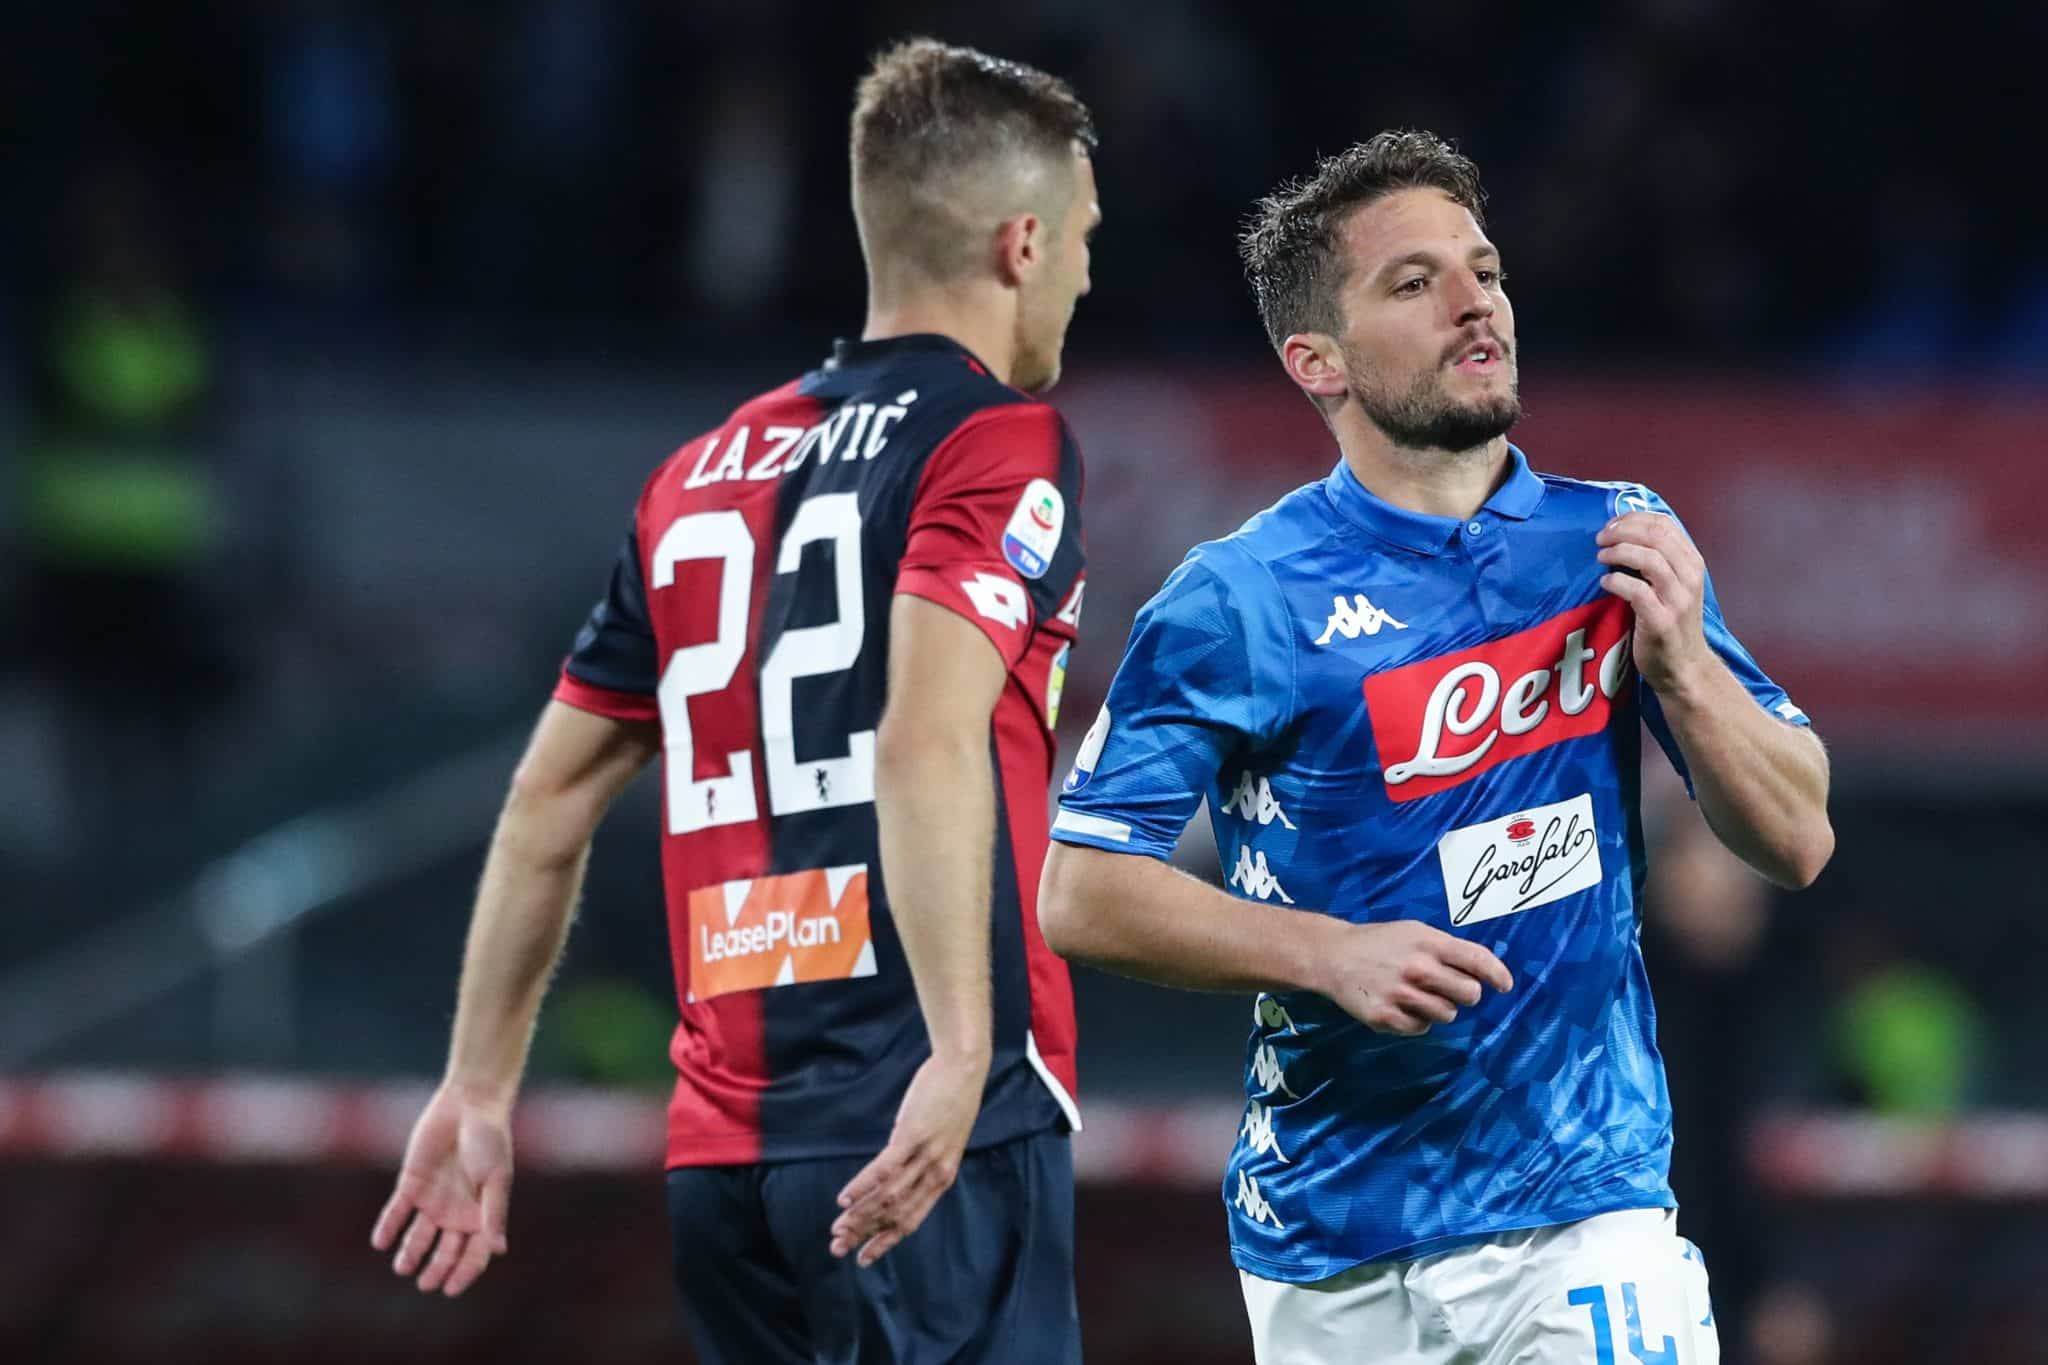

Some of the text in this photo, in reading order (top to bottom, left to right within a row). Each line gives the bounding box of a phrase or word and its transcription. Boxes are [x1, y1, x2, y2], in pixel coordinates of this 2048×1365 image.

[683, 389, 918, 490] LAZOVIĆ
[652, 491, 877, 836] 22
[1453, 813, 1595, 926] Garofalo
[701, 910, 841, 964] LeasePlan
